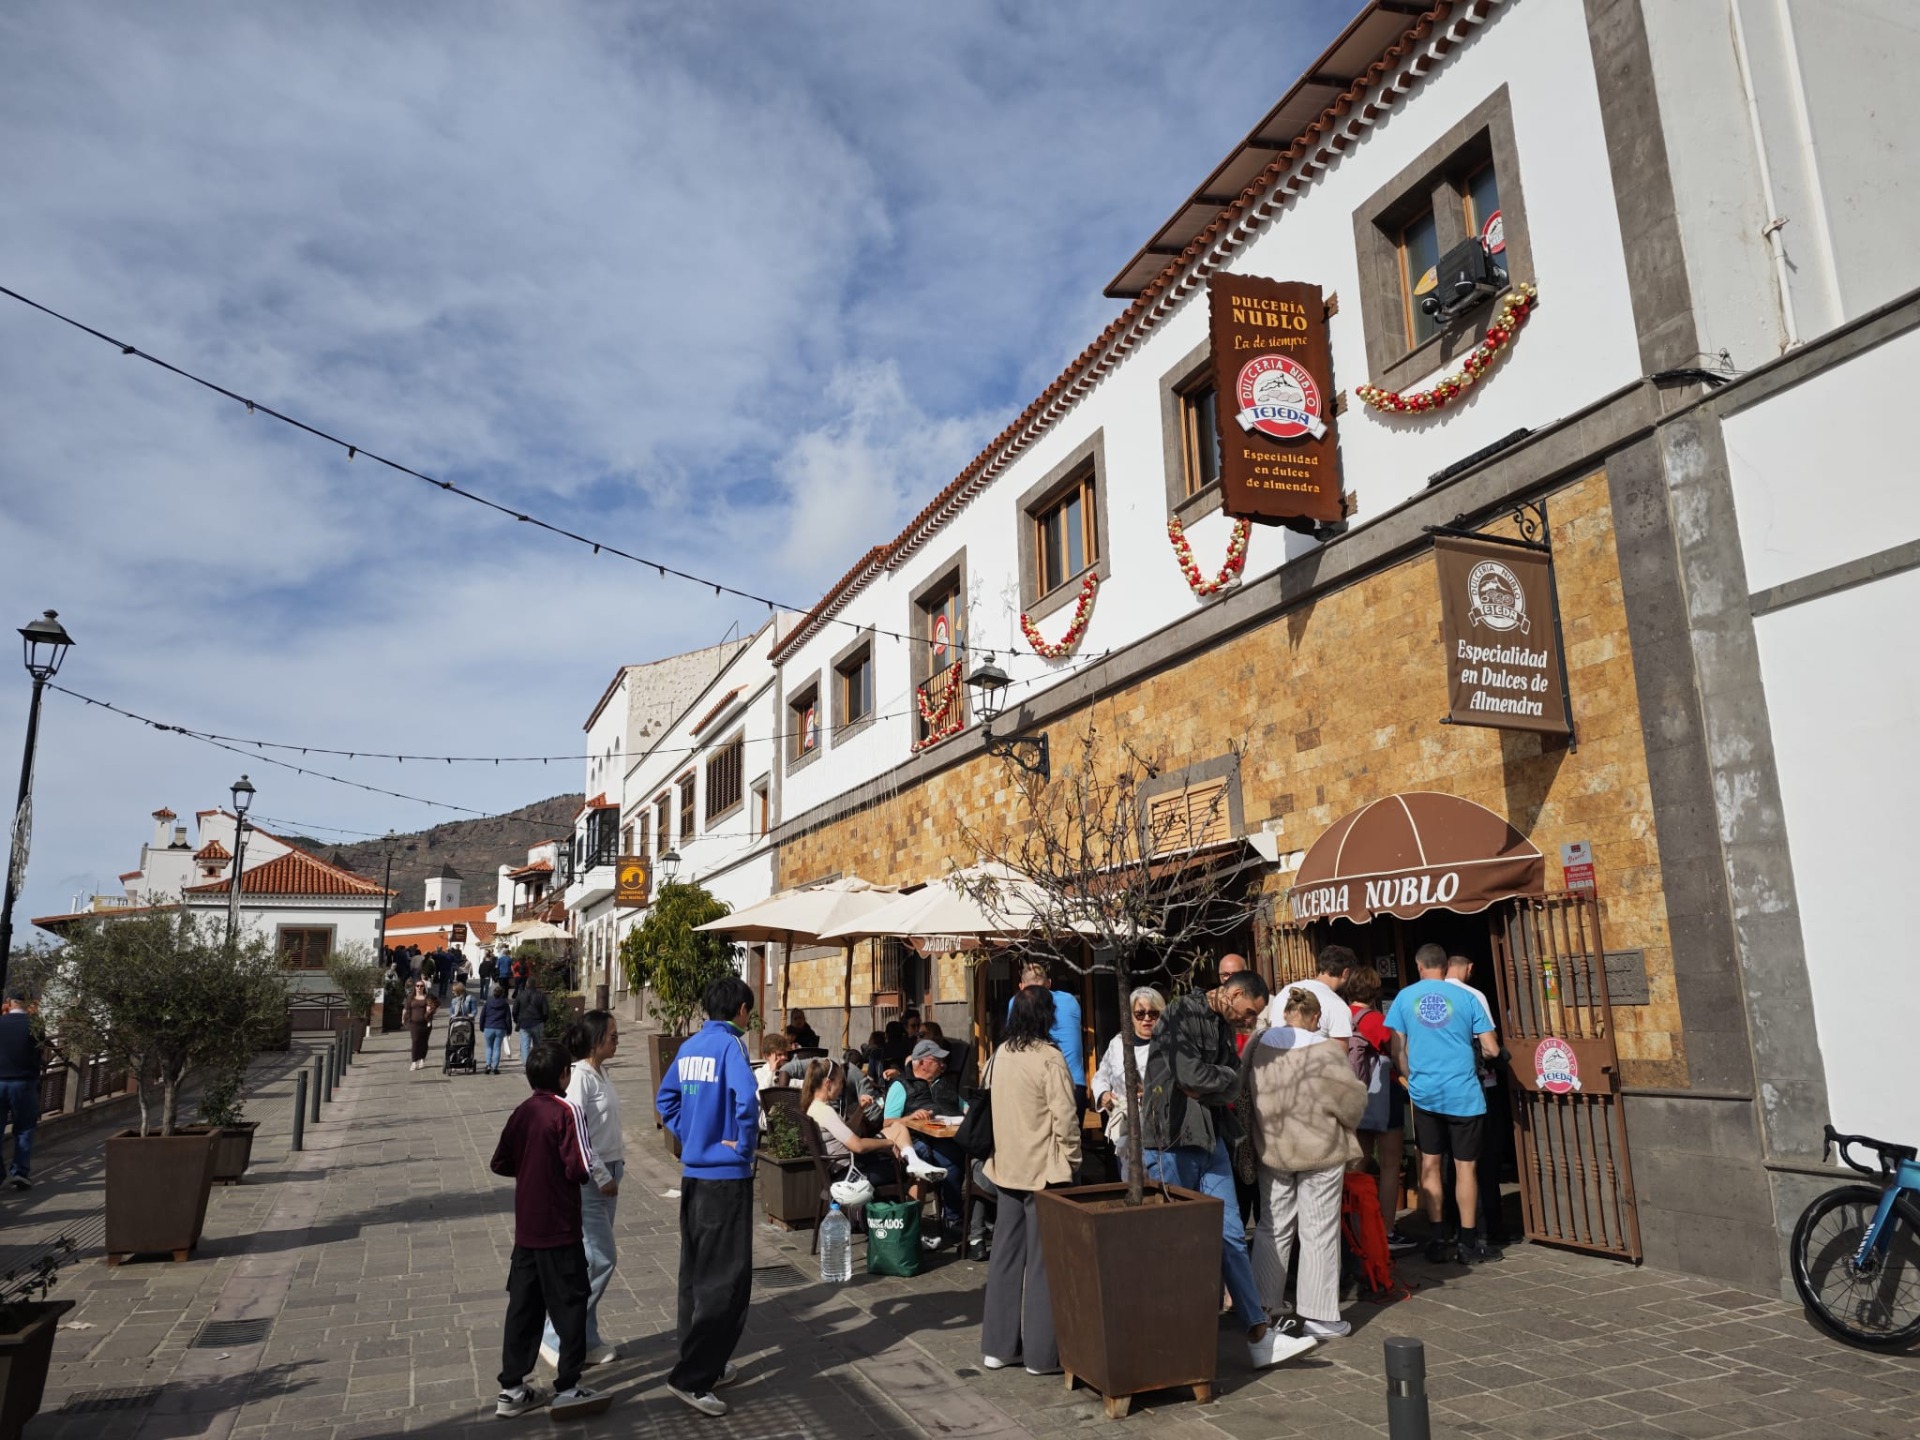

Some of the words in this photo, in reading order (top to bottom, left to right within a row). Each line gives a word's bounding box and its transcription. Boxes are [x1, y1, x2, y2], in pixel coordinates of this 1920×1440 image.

[1232, 308, 1308, 331] NUBLO
[1234, 335, 1250, 350] La
[1253, 334, 1266, 348] de
[1269, 336, 1308, 352] siempre
[1242, 359, 1283, 399] DULCERIA
[1289, 365, 1316, 407] NUBLO
[1250, 406, 1310, 426] TEJEDA
[1243, 449, 1319, 465] Especialidad
[1254, 466, 1269, 475] en
[1272, 466, 1310, 478] dulces
[1246, 478, 1260, 488] de
[1263, 480, 1321, 493] almendra
[1471, 564, 1495, 596] DULCERIA
[1501, 569, 1521, 600] NUBLO
[1458, 639, 1548, 669] Especialidad
[1461, 669, 1478, 685] en
[1481, 667, 1528, 692] Dulces
[1531, 673, 1549, 693] de
[1470, 690, 1543, 717] Almendra
[1365, 872, 1460, 909] NUBLO
[1542, 1072, 1573, 1083] TEJEDA
